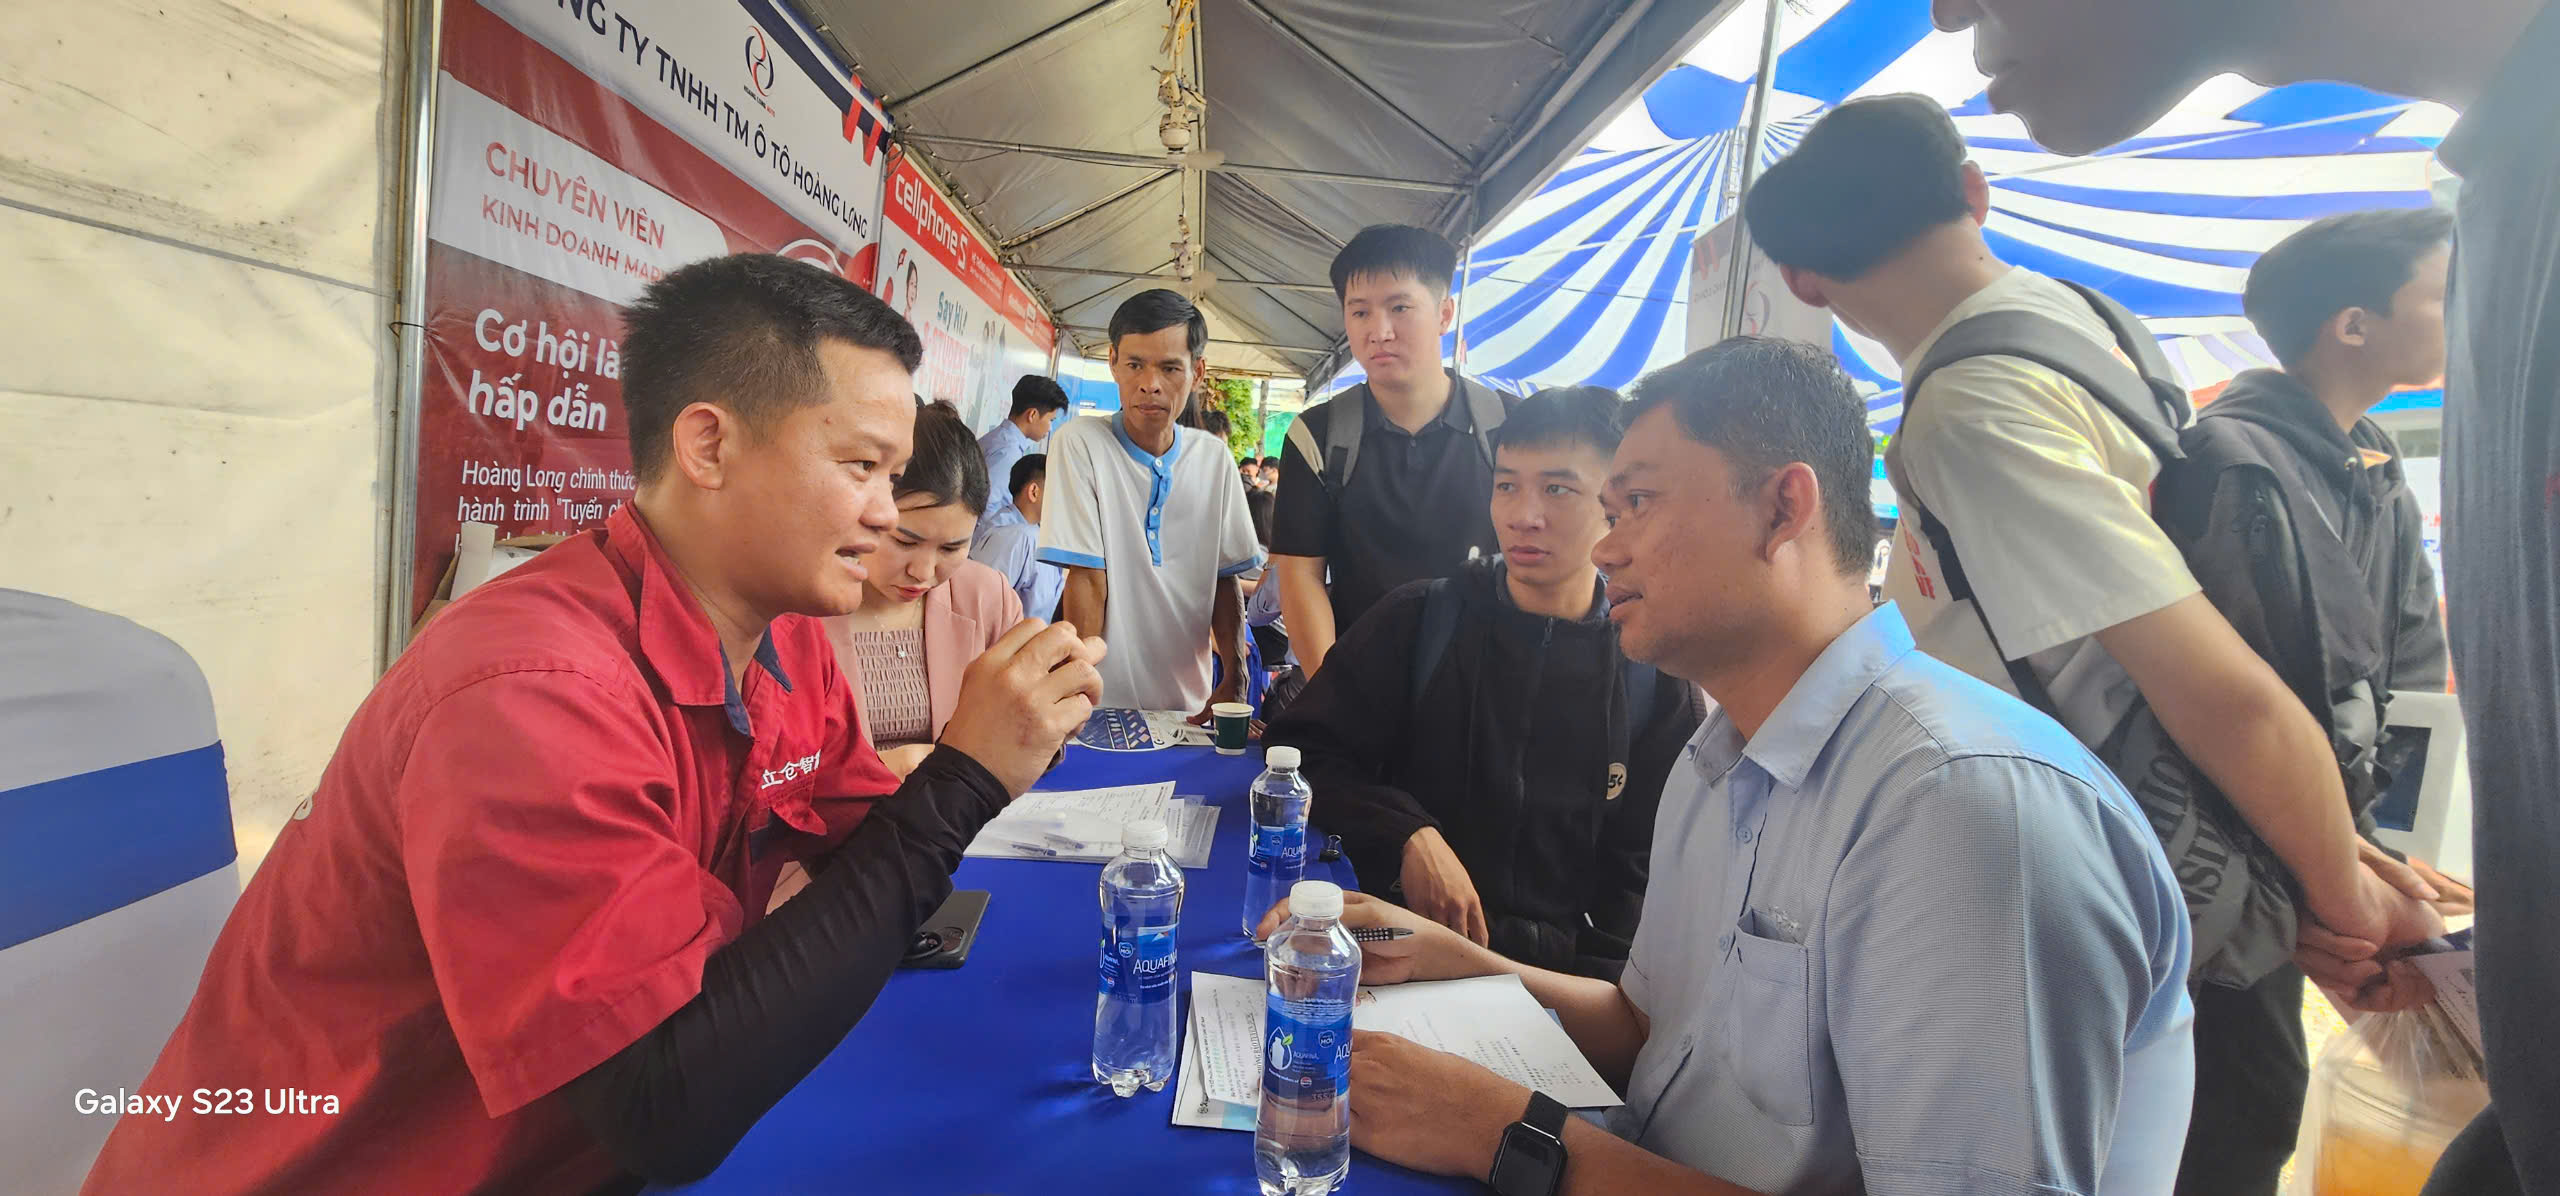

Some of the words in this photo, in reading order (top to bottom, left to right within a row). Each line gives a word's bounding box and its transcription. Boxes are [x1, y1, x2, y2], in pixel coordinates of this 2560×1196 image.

[615, 12, 649, 66] TY
[656, 45, 718, 123] TNHH
[724, 101, 749, 147] TM
[754, 123, 766, 158] Ô
[771, 141, 790, 177] TÔ
[794, 161, 840, 216] HOÀNG
[486, 141, 607, 223] CHUYÊN
[614, 200, 664, 249] VIÊN
[482, 194, 540, 240] KINH
[546, 222, 619, 272] DOANH
[625, 255, 665, 282] MAR
[475, 308, 528, 357] Cơ
[536, 321, 591, 379] hội
[468, 369, 539, 431] hấp
[547, 382, 607, 431] dẫn
[457, 496, 504, 521] hành
[514, 498, 549, 521] trình
[461, 460, 521, 493] Hoàng
[526, 464, 565, 493] Long
[570, 467, 606, 490] chính
